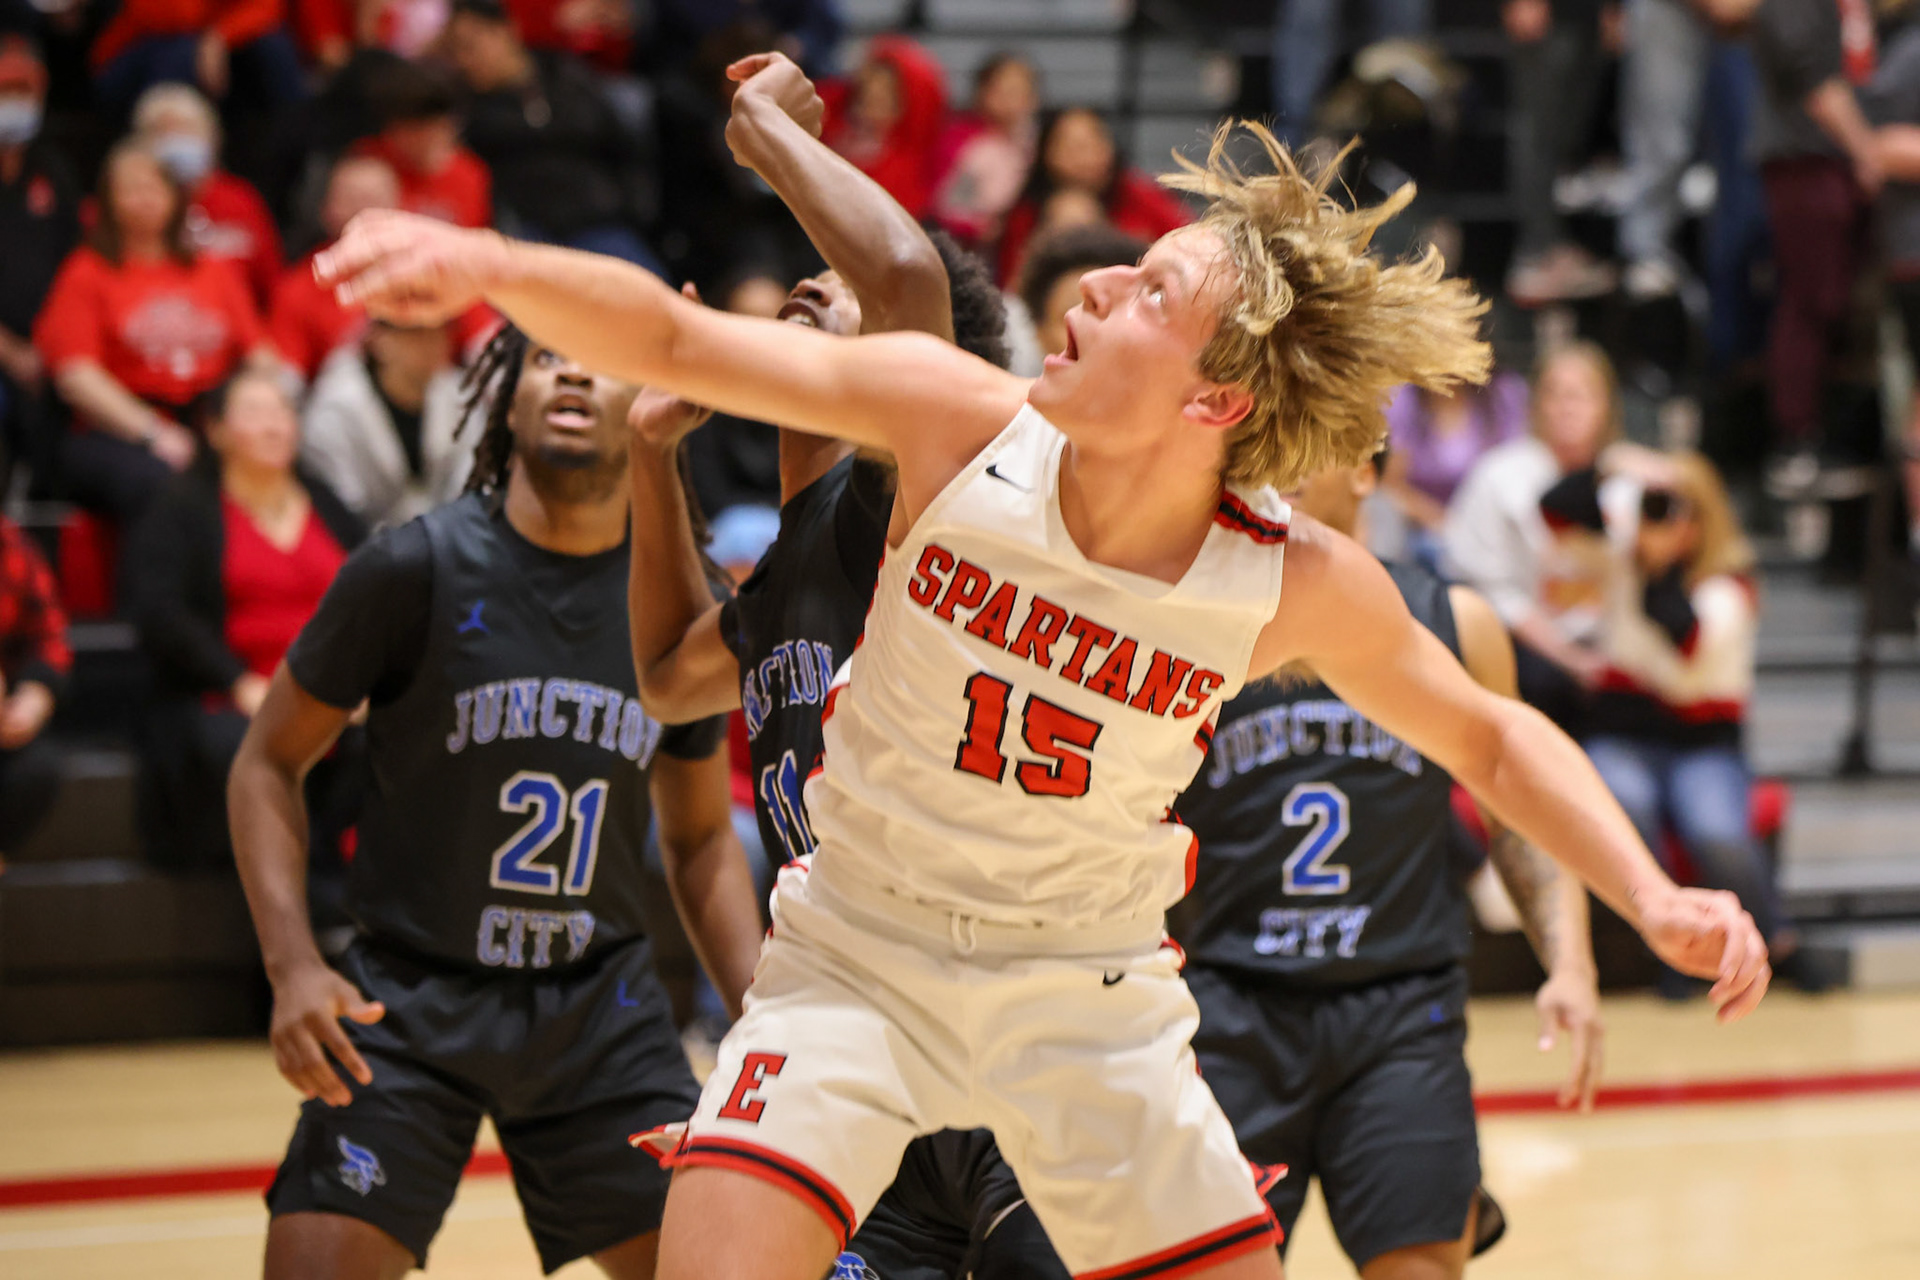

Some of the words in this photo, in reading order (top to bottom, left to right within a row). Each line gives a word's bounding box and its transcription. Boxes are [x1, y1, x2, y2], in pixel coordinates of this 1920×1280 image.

[908, 541, 1225, 720] SPARTANS
[742, 638, 834, 741] NCTION
[953, 669, 1105, 799] 15
[489, 770, 610, 896] 21
[760, 748, 817, 860] 11
[1281, 781, 1352, 896] 2
[476, 904, 596, 969] CITY
[716, 1050, 789, 1124] E
